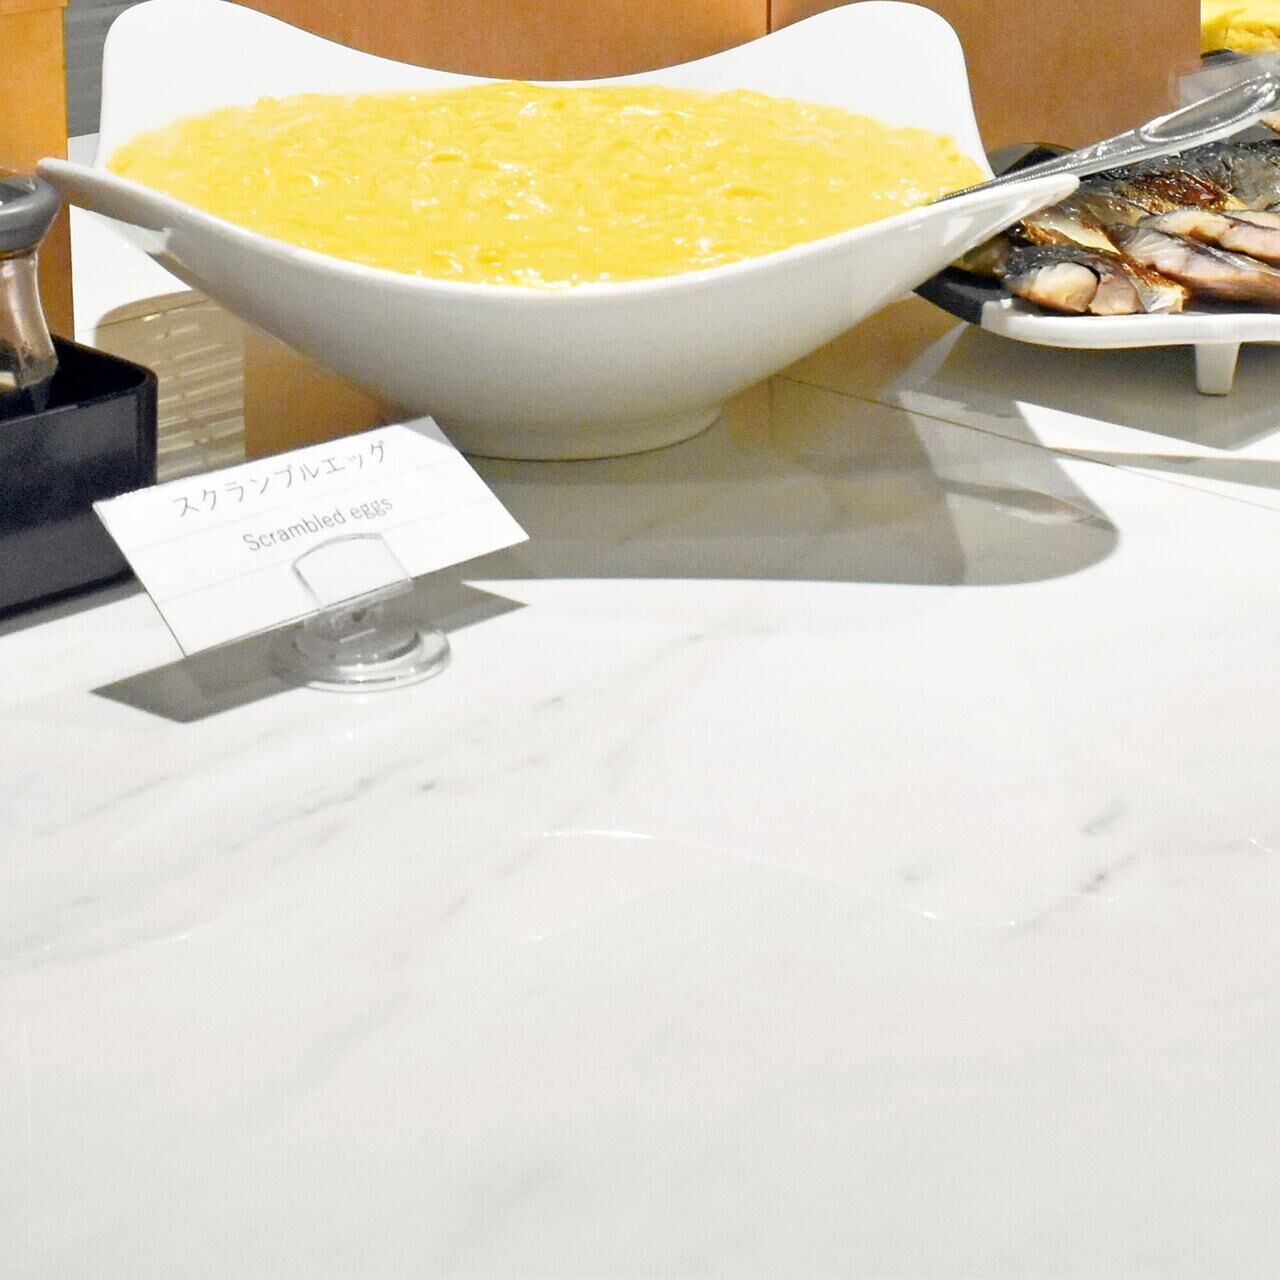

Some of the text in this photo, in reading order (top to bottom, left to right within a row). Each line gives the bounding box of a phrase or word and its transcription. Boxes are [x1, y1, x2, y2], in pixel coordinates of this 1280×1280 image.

[172, 439, 387, 519] スクランブルエッグ
[242, 497, 395, 551] Scrambled eggs
